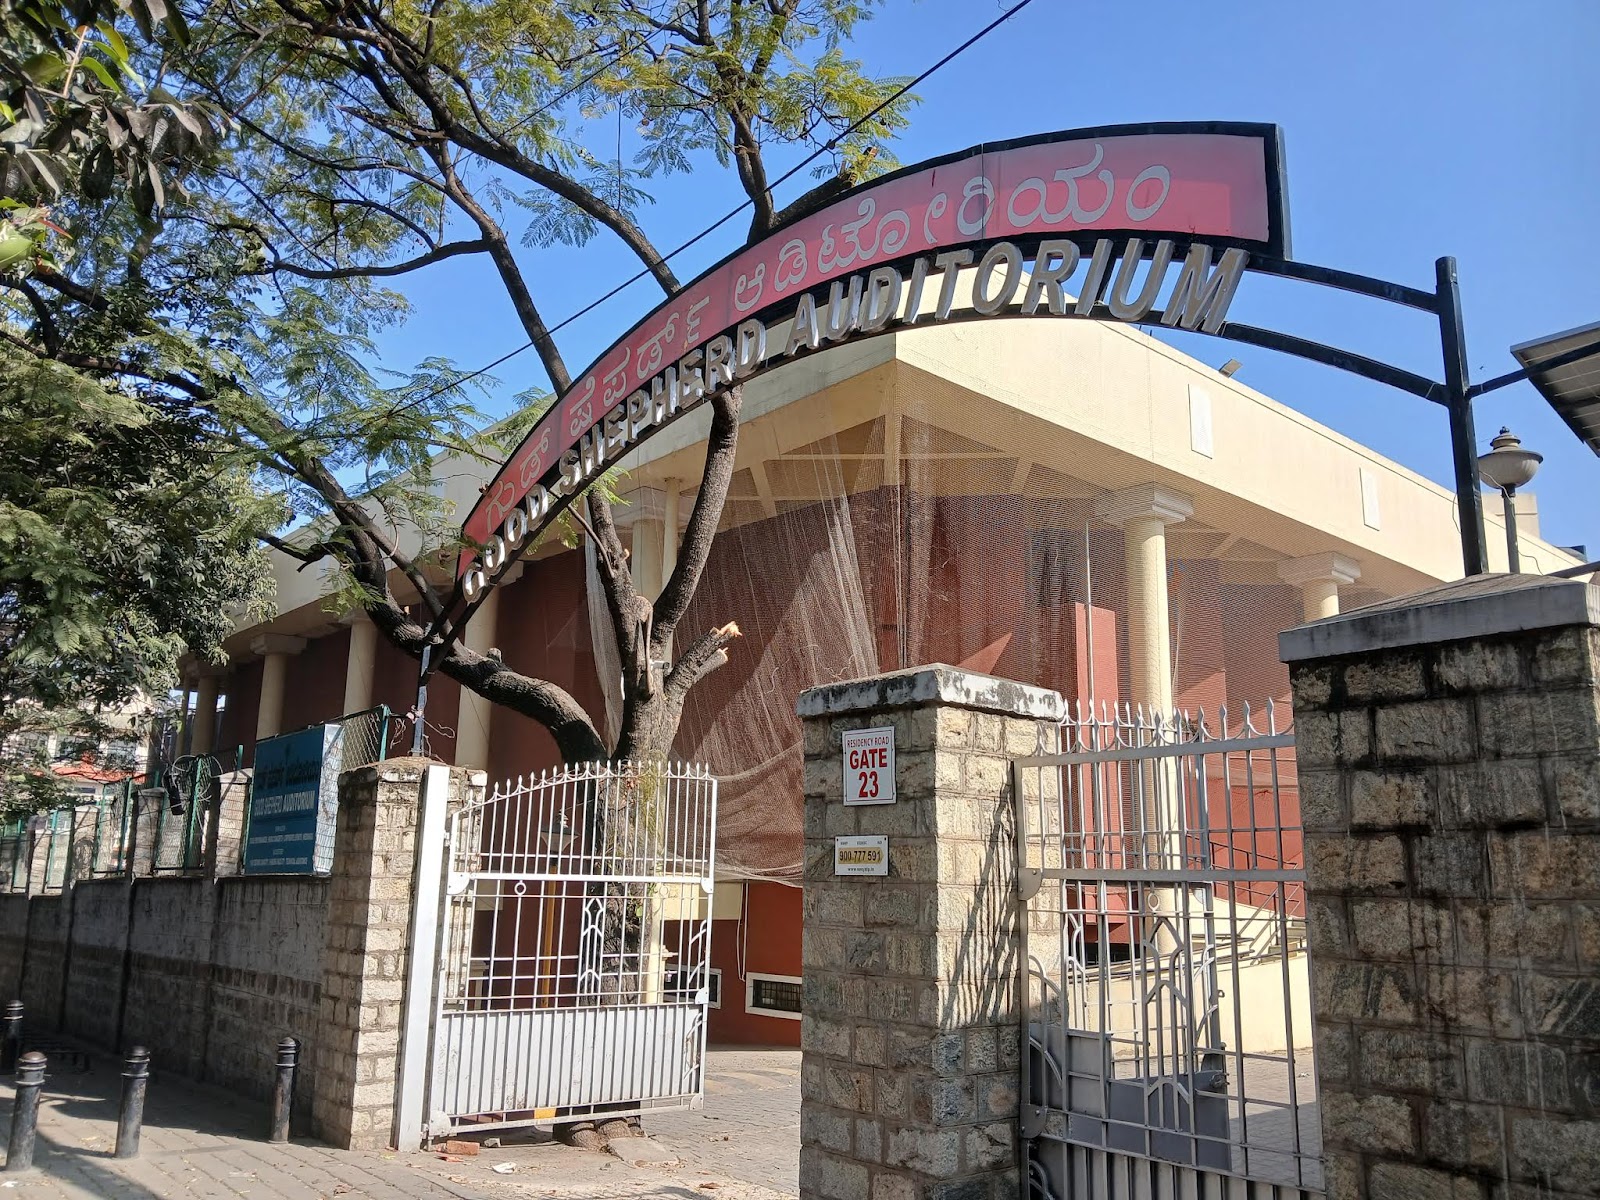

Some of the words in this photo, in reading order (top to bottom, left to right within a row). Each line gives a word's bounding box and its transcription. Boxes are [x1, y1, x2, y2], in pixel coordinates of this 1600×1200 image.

[462, 483, 549, 604] GOOD
[559, 317, 767, 495] SHEPHERD
[783, 238, 1250, 357] AUDITORIUM
[847, 738, 873, 748] RESIDENCY
[874, 736, 890, 746] ROAD
[850, 748, 888, 770] GATE
[858, 771, 879, 798] 23
